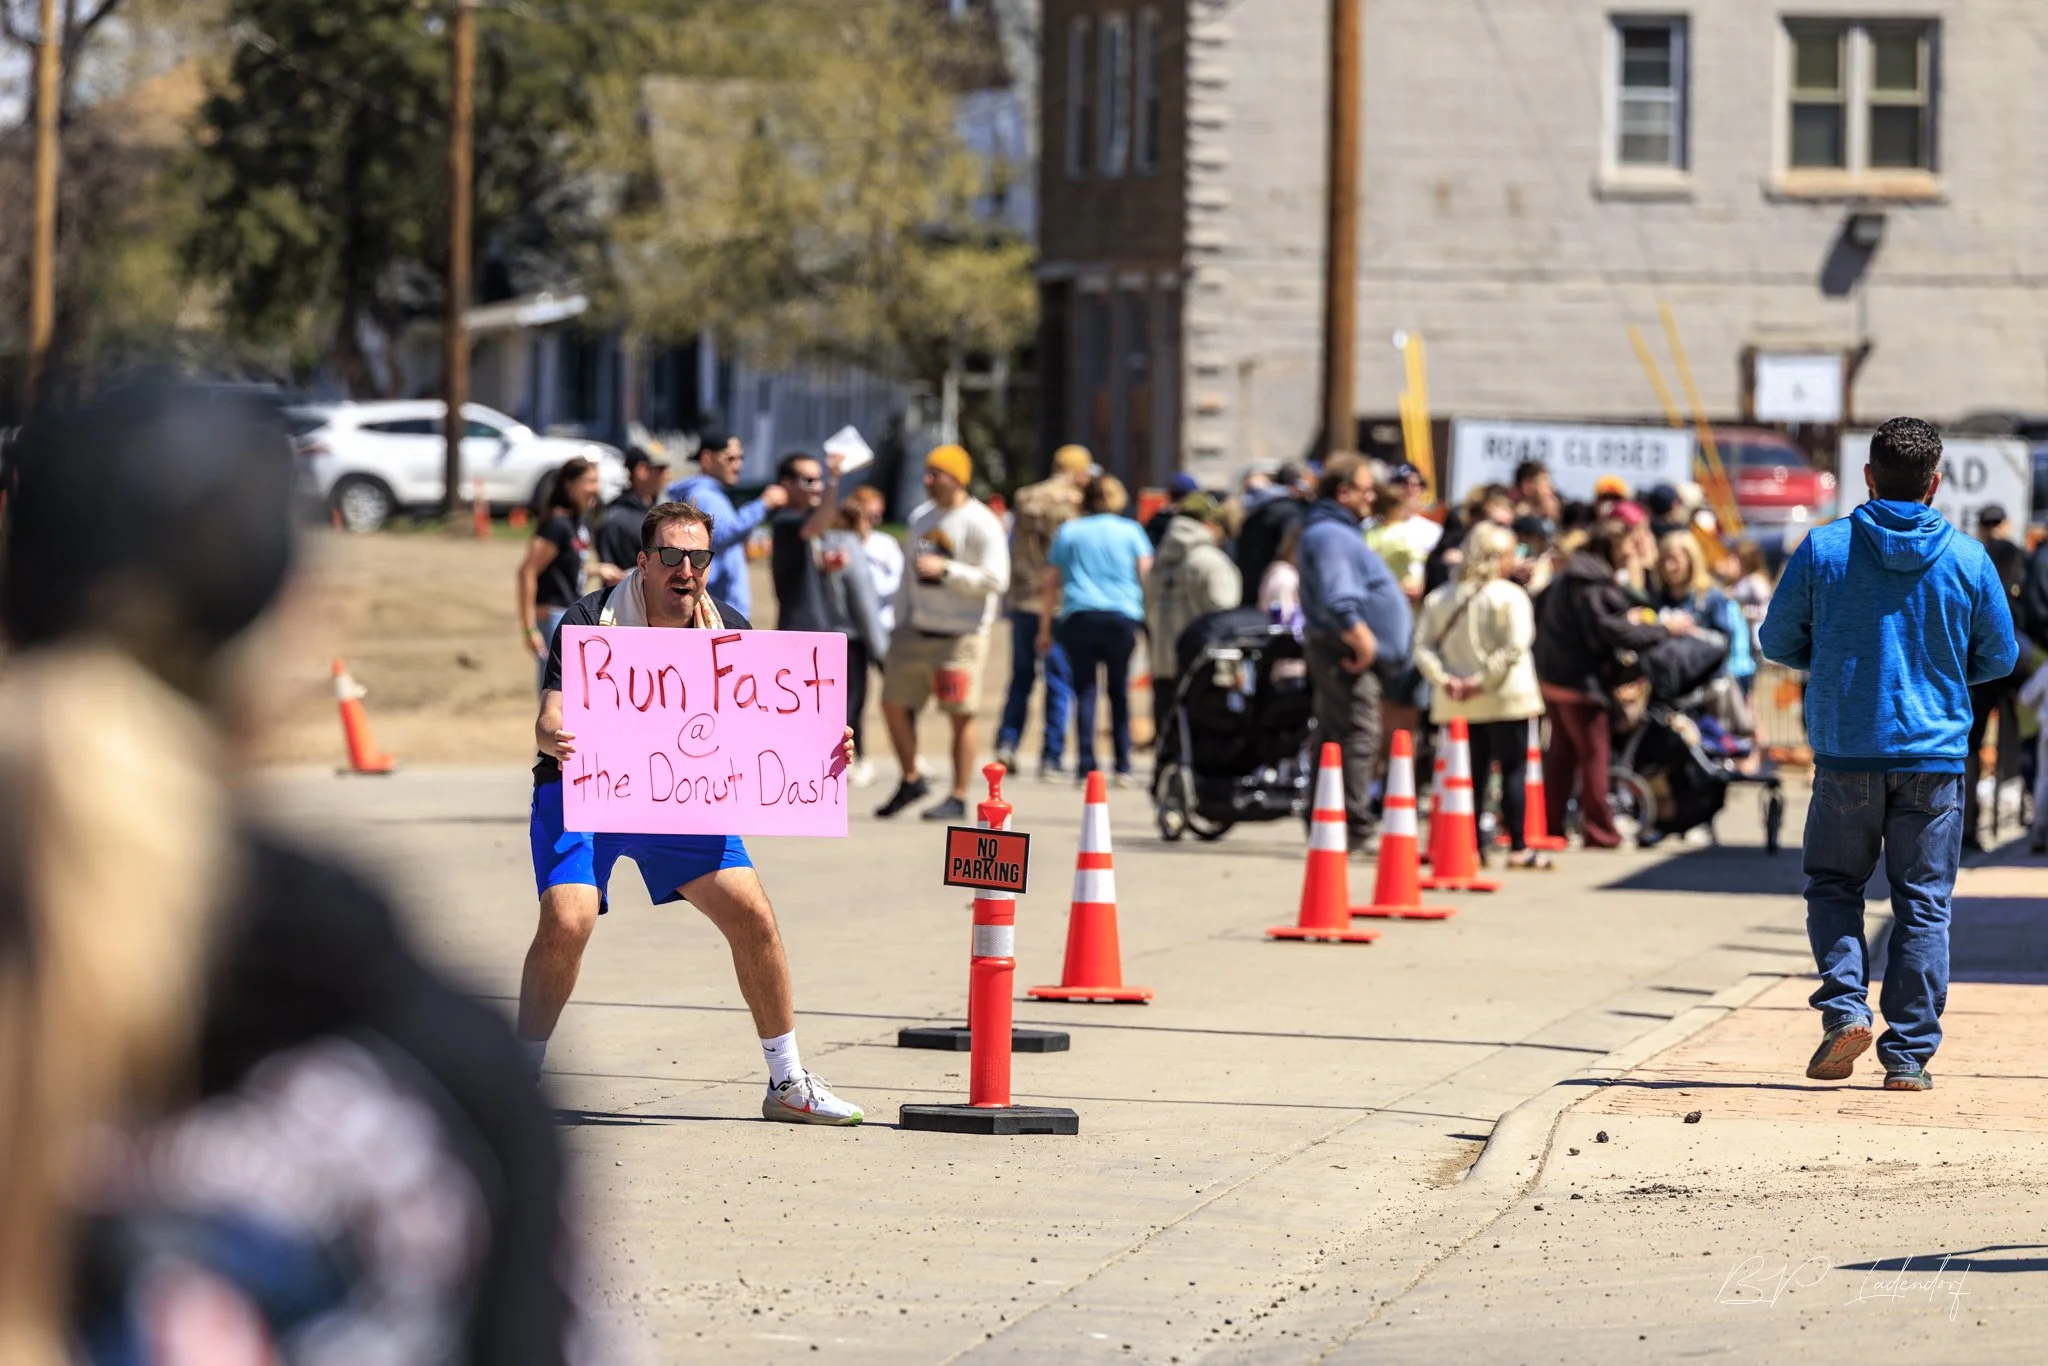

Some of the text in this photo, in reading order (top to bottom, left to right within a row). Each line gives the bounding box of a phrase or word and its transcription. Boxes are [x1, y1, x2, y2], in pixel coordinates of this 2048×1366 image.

[1483, 435, 1668, 470] ROAD CLOSED
[1941, 456, 1988, 494] AD
[579, 633, 835, 714] Run Fast
[678, 712, 719, 757] @
[573, 749, 839, 806] the Donut Dash
[977, 837, 998, 858] NO
[952, 857, 1019, 883] PARKING
